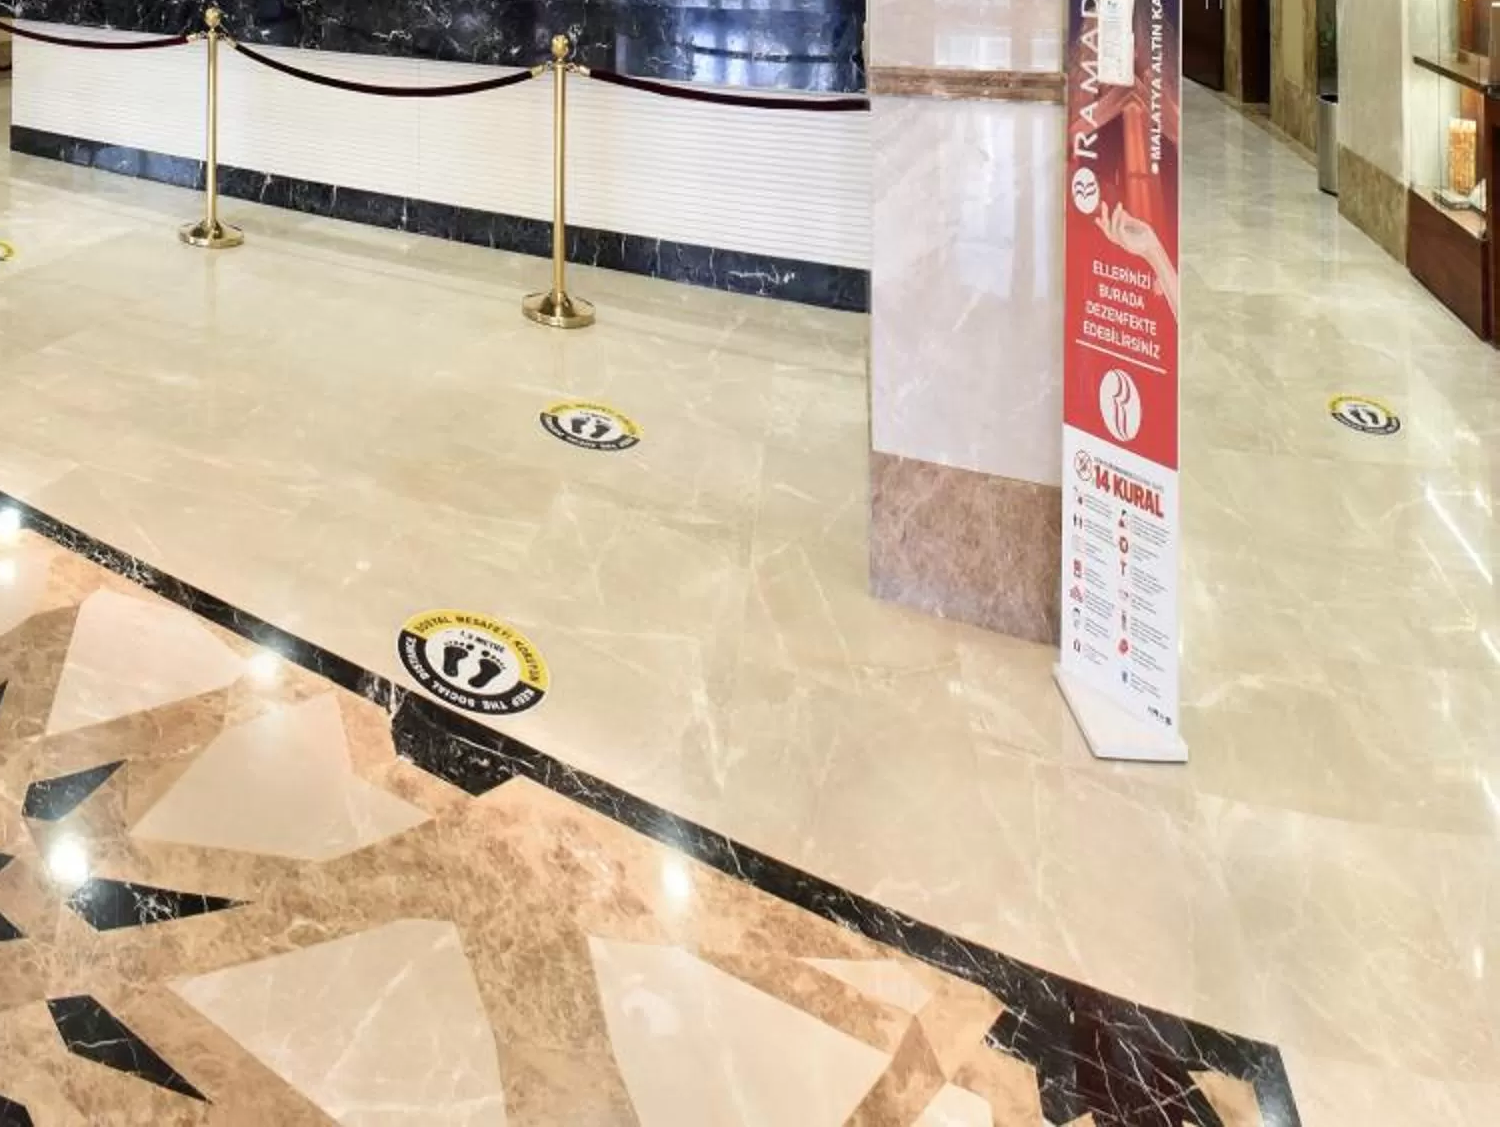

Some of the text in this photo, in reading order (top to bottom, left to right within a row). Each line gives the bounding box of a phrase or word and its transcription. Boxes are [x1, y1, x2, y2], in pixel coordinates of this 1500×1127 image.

[1149, 77, 1163, 160] MALATYA
[1098, 283, 1145, 310] BURADA
[1085, 300, 1157, 336] DEZENFEKTE
[1094, 464, 1110, 493] 14
[1113, 473, 1164, 518] KURAL
[432, 680, 475, 707] SOCIAL
[481, 700, 508, 710] THE
